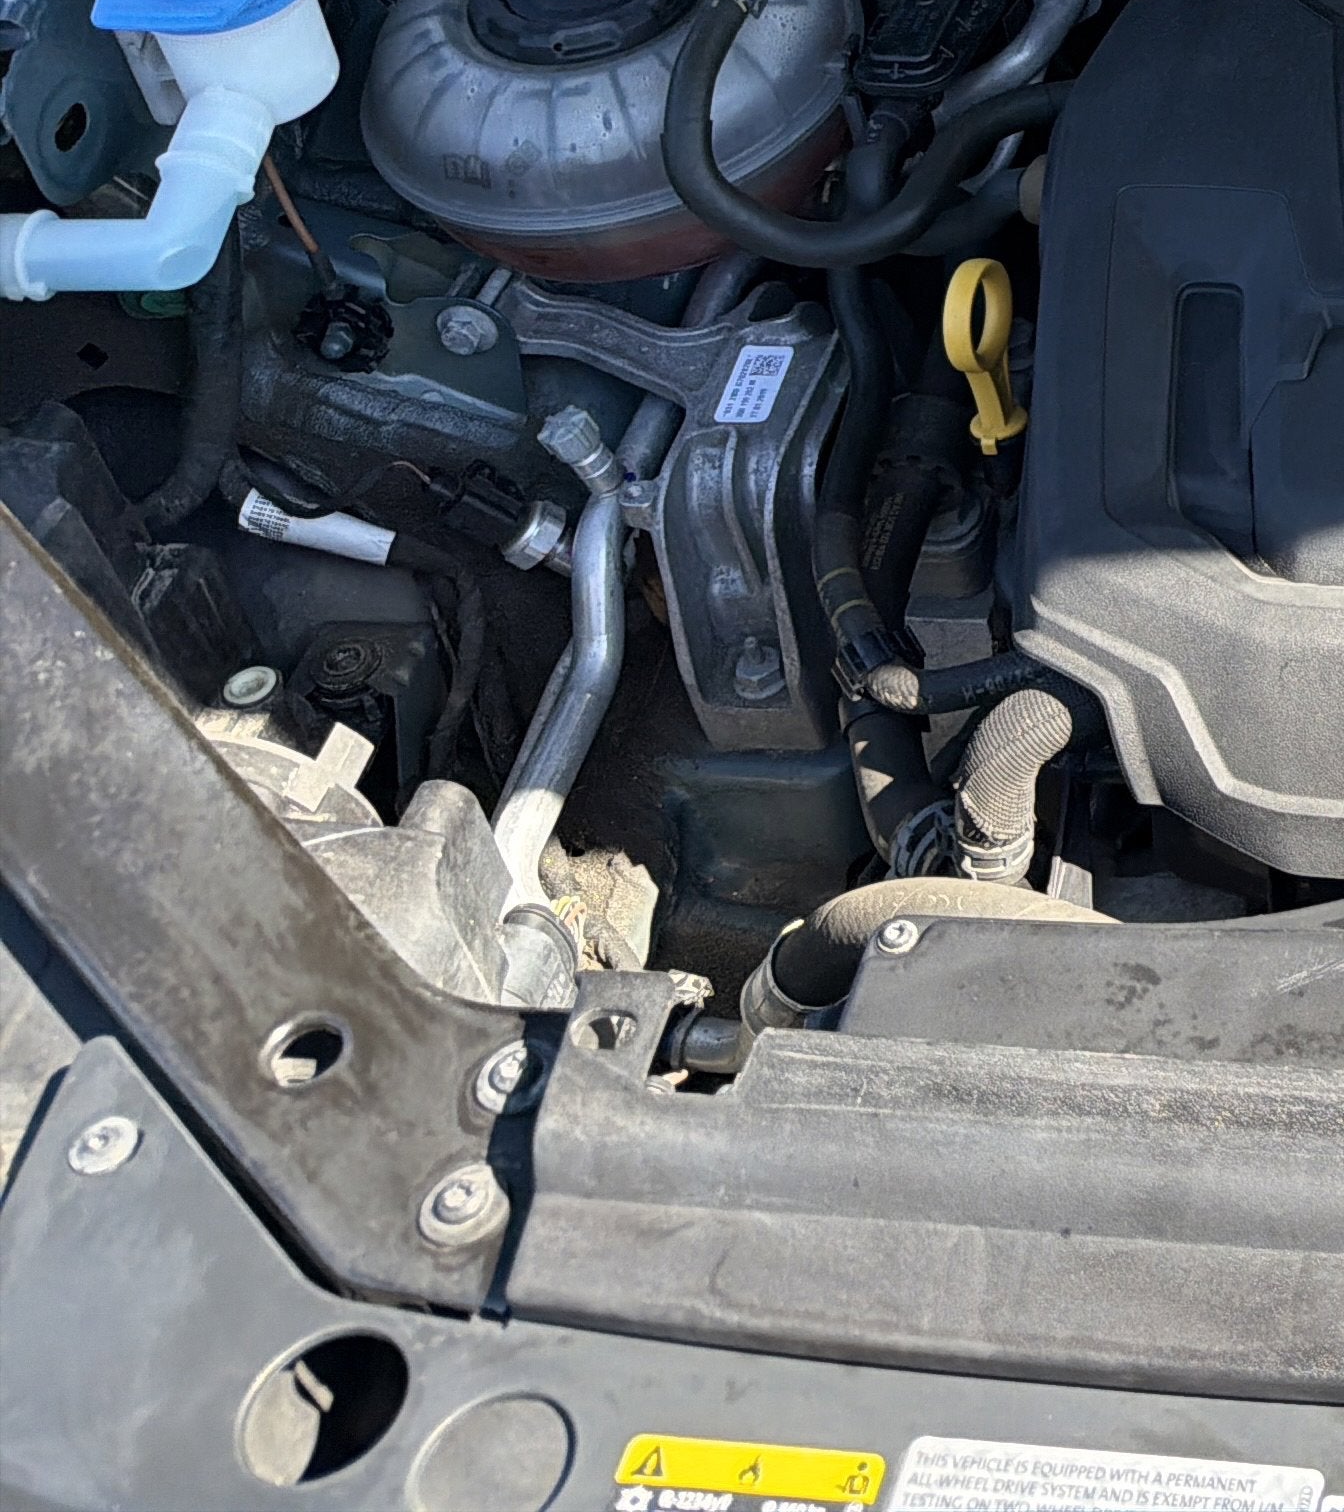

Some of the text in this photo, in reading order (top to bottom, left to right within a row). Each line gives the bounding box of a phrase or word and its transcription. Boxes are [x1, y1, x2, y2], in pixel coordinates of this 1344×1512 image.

[906, 1471, 992, 1489] ALL-WHEEL
[993, 1478, 1040, 1496] DRIVE
[1041, 1482, 1097, 1500] SYSTEM
[1099, 1487, 1134, 1504] AND
[1136, 1491, 1150, 1506] IS
[1151, 1492, 1212, 1510] EXEMPT
[1213, 1497, 1257, 1512] FROM
[915, 1450, 1258, 1494] THIS VEHICLE IS EQUIPPED WITH A PERMANENT
[902, 1492, 963, 1509] TESTING
[966, 1497, 991, 1512] ON
